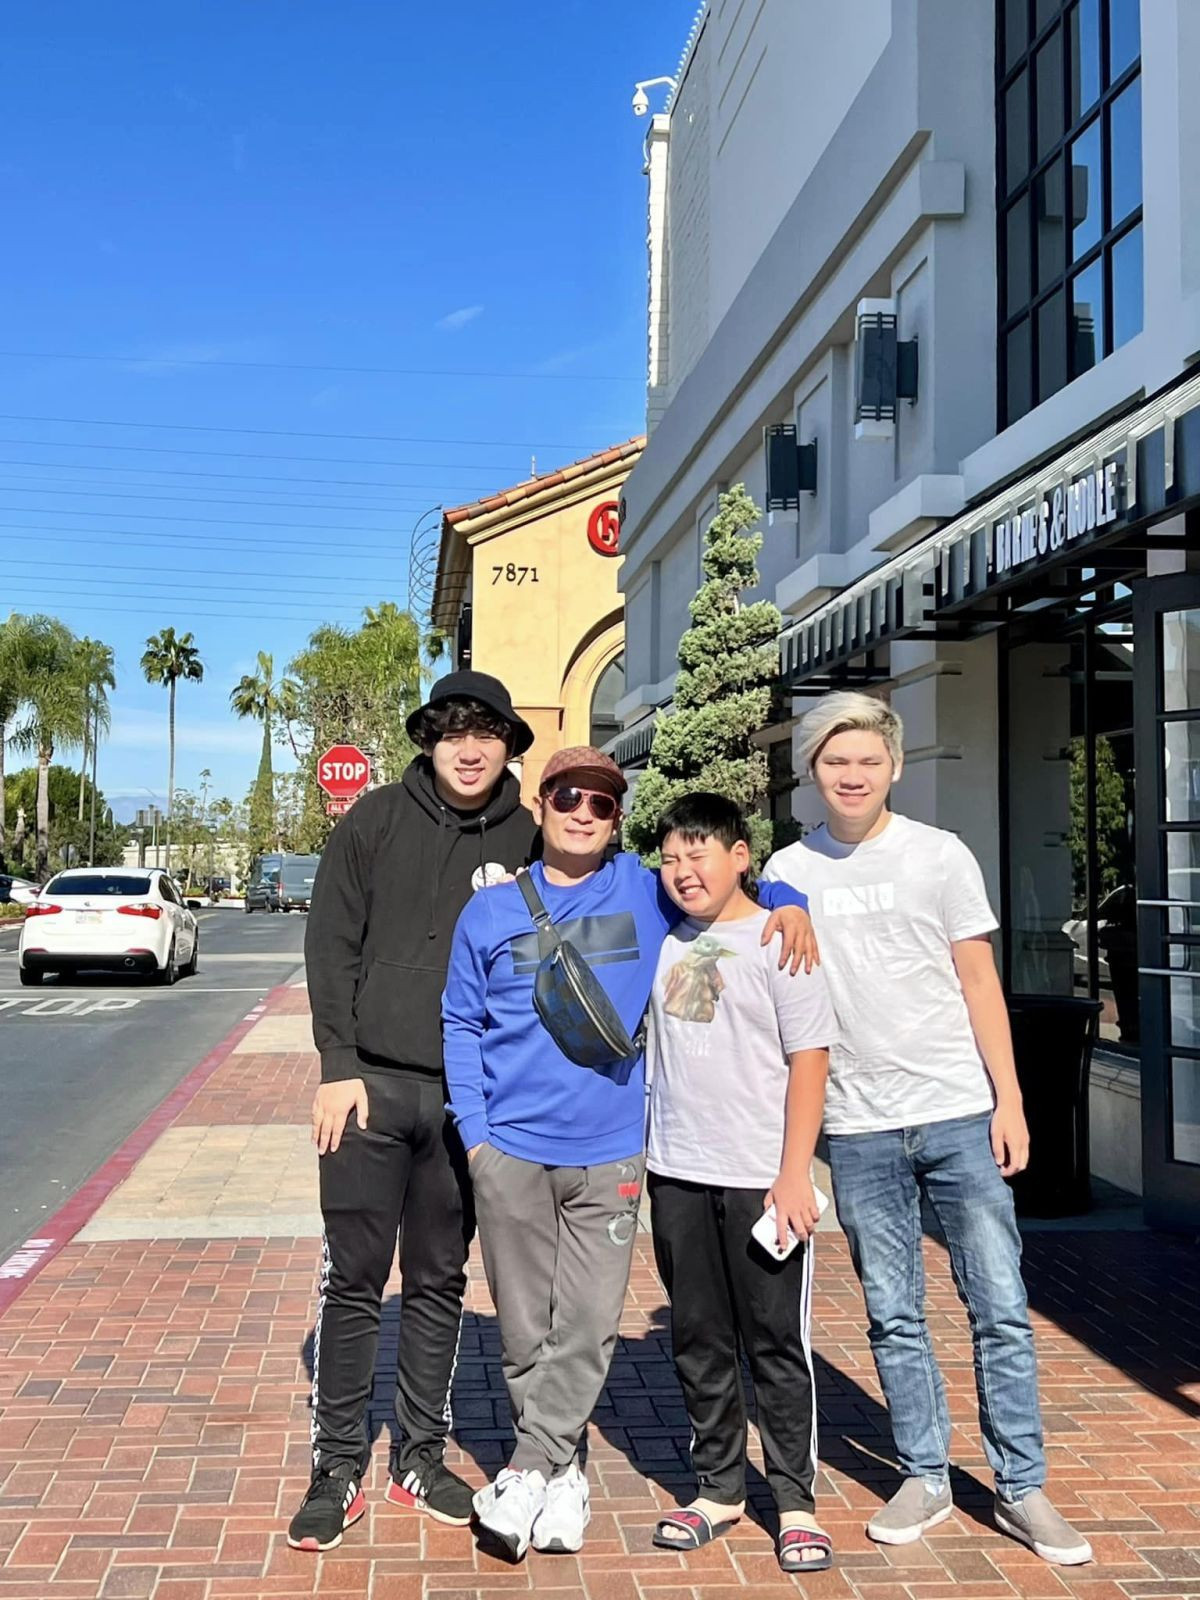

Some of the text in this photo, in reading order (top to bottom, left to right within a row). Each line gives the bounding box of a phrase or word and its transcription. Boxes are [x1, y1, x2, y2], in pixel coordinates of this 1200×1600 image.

[996, 462, 1117, 574] BARNES & NOBLE
[492, 562, 539, 586] 7871
[321, 762, 366, 781] STOP
[0, 998, 141, 1016] TOP
